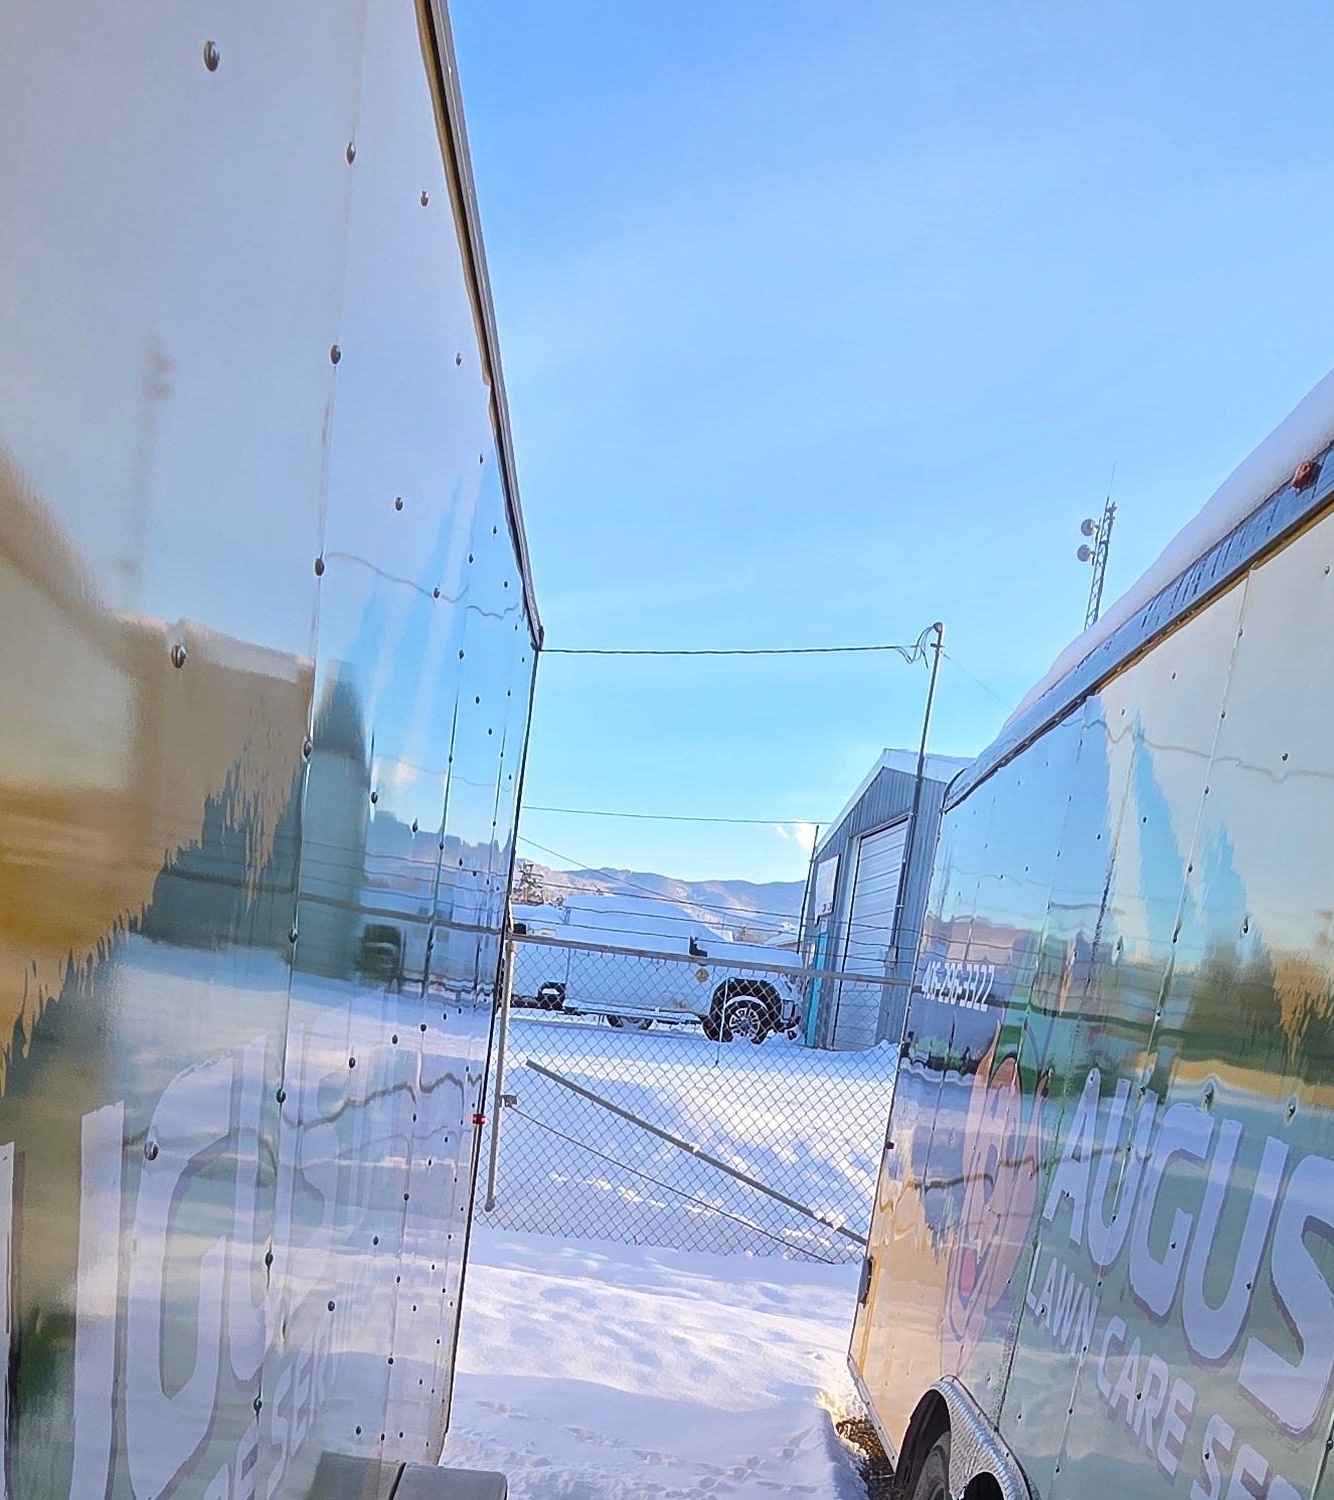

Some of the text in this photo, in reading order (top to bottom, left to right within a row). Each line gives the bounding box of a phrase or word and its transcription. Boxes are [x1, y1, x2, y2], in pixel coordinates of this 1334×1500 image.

[265, 1278, 369, 1500] SERV
[1026, 1240, 1099, 1364] LAWN
[1098, 1318, 1197, 1478] CARE
